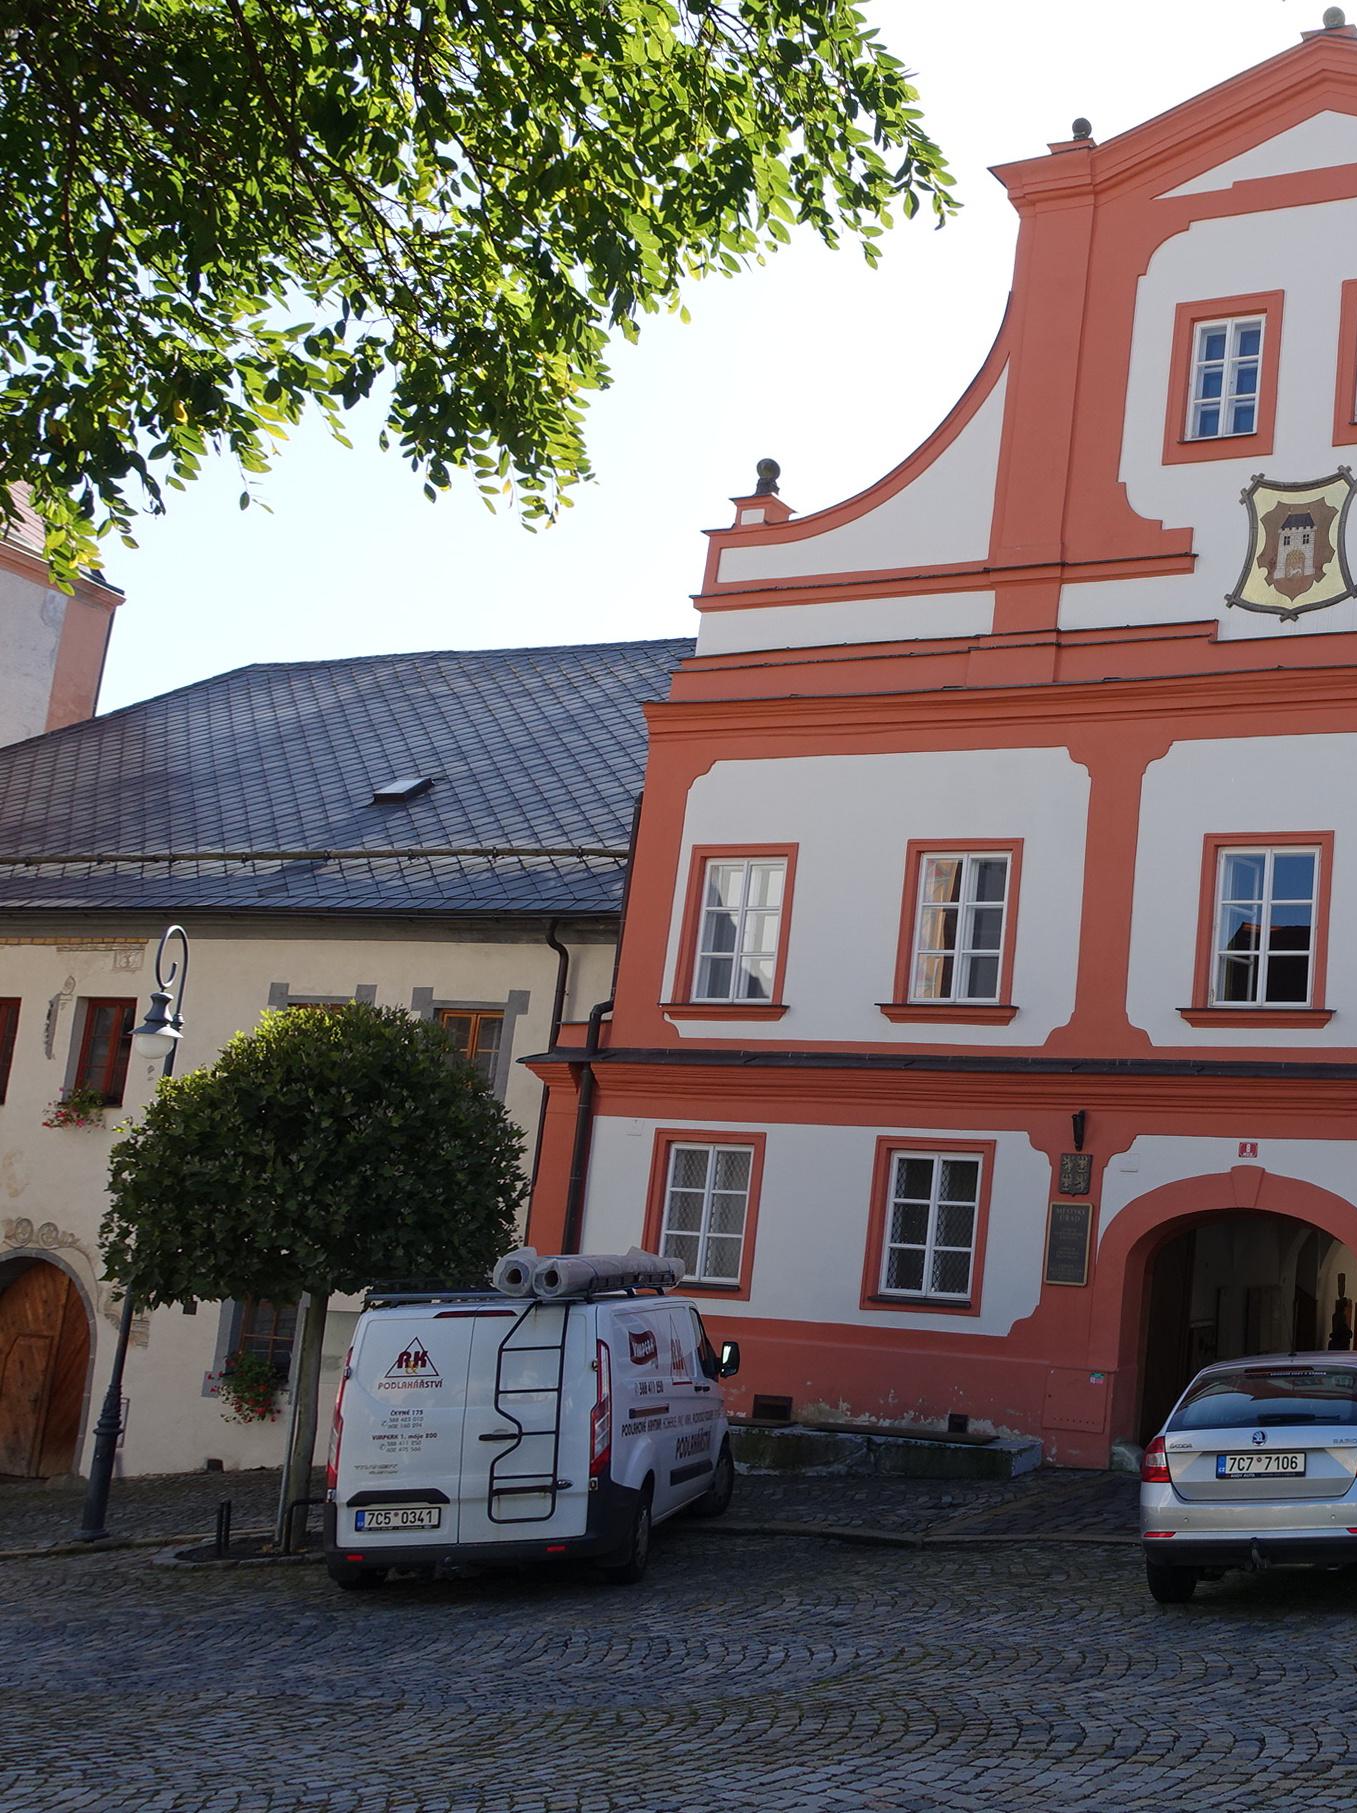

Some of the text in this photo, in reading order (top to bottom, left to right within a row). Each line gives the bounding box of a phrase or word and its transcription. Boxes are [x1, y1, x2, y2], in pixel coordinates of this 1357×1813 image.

[1246, 1143, 1251, 1153] 8
[377, 1378, 444, 1390] PODLAHÁŘSTVÍ
[1228, 1455, 1299, 1472] 7C7 7106
[367, 1510, 433, 1526] 7C5 0341
